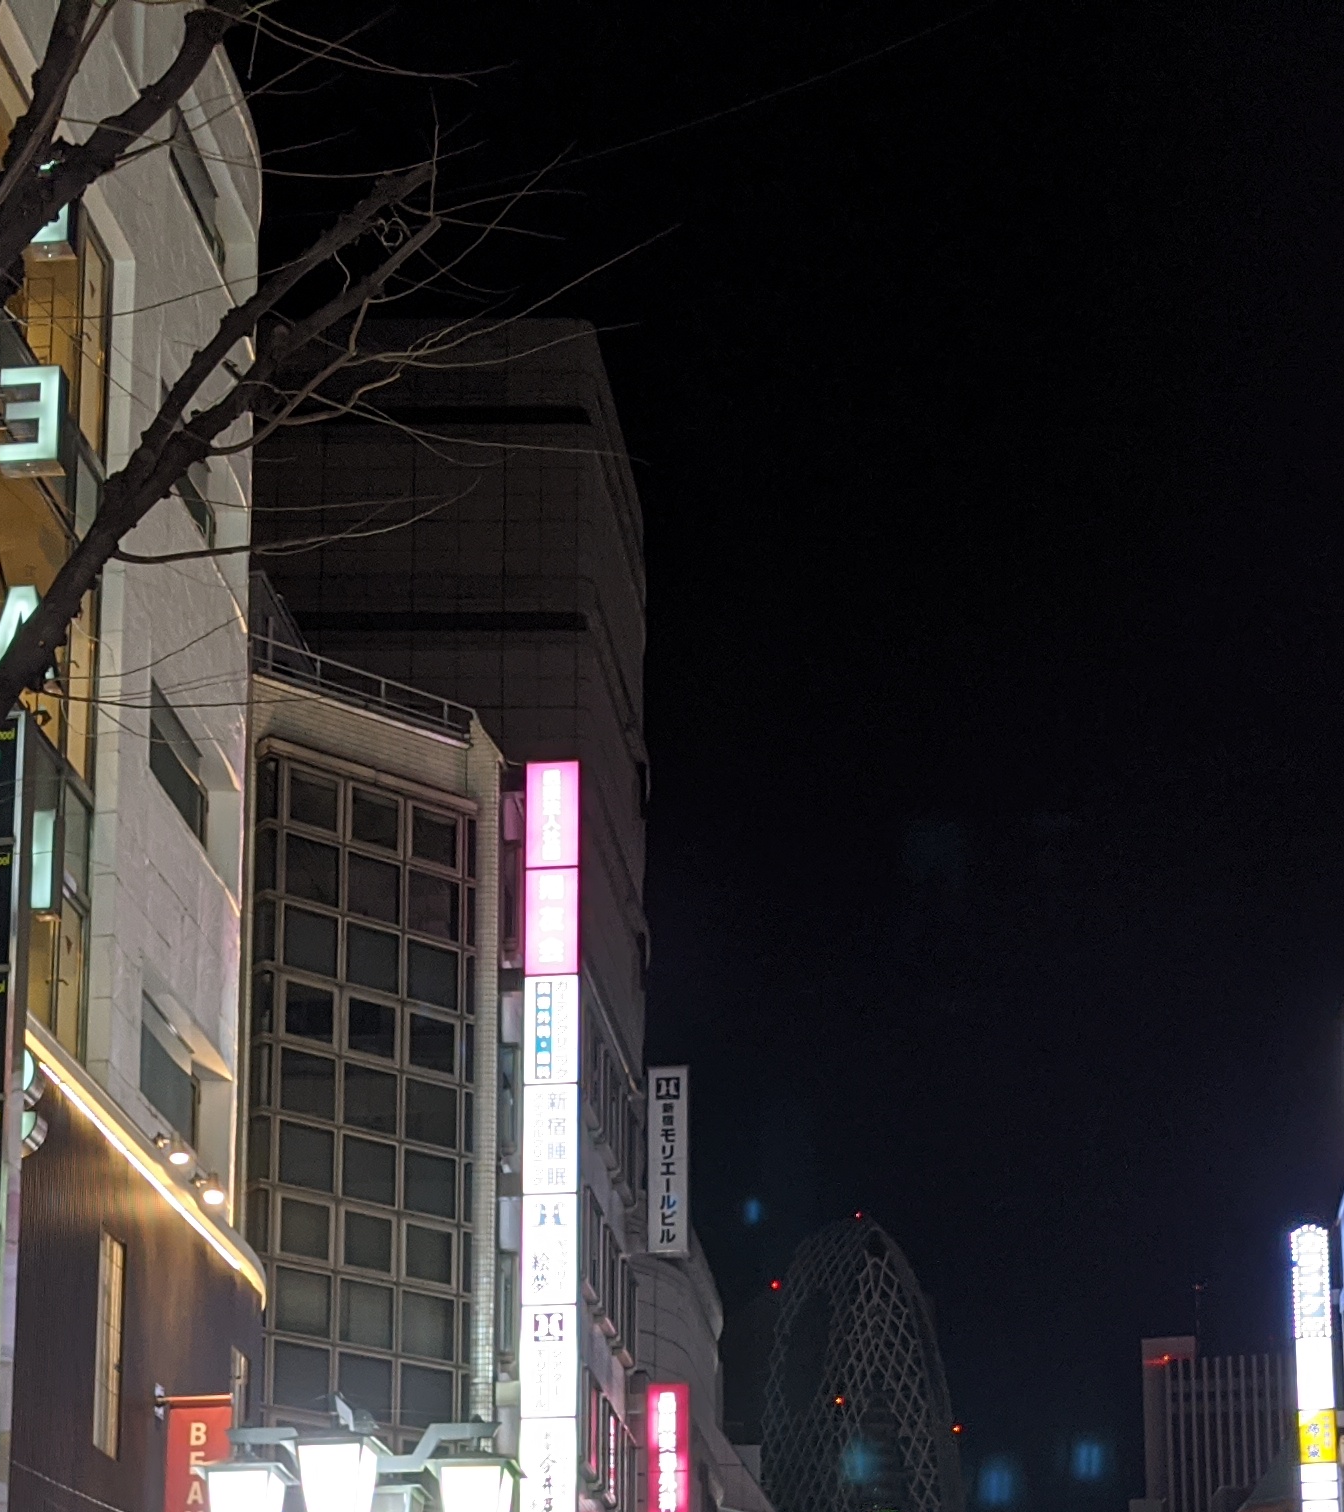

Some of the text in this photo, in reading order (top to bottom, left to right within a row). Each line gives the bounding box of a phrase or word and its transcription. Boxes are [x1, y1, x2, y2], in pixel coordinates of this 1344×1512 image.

[659, 1102, 677, 1244] 新宿モリエールビル
